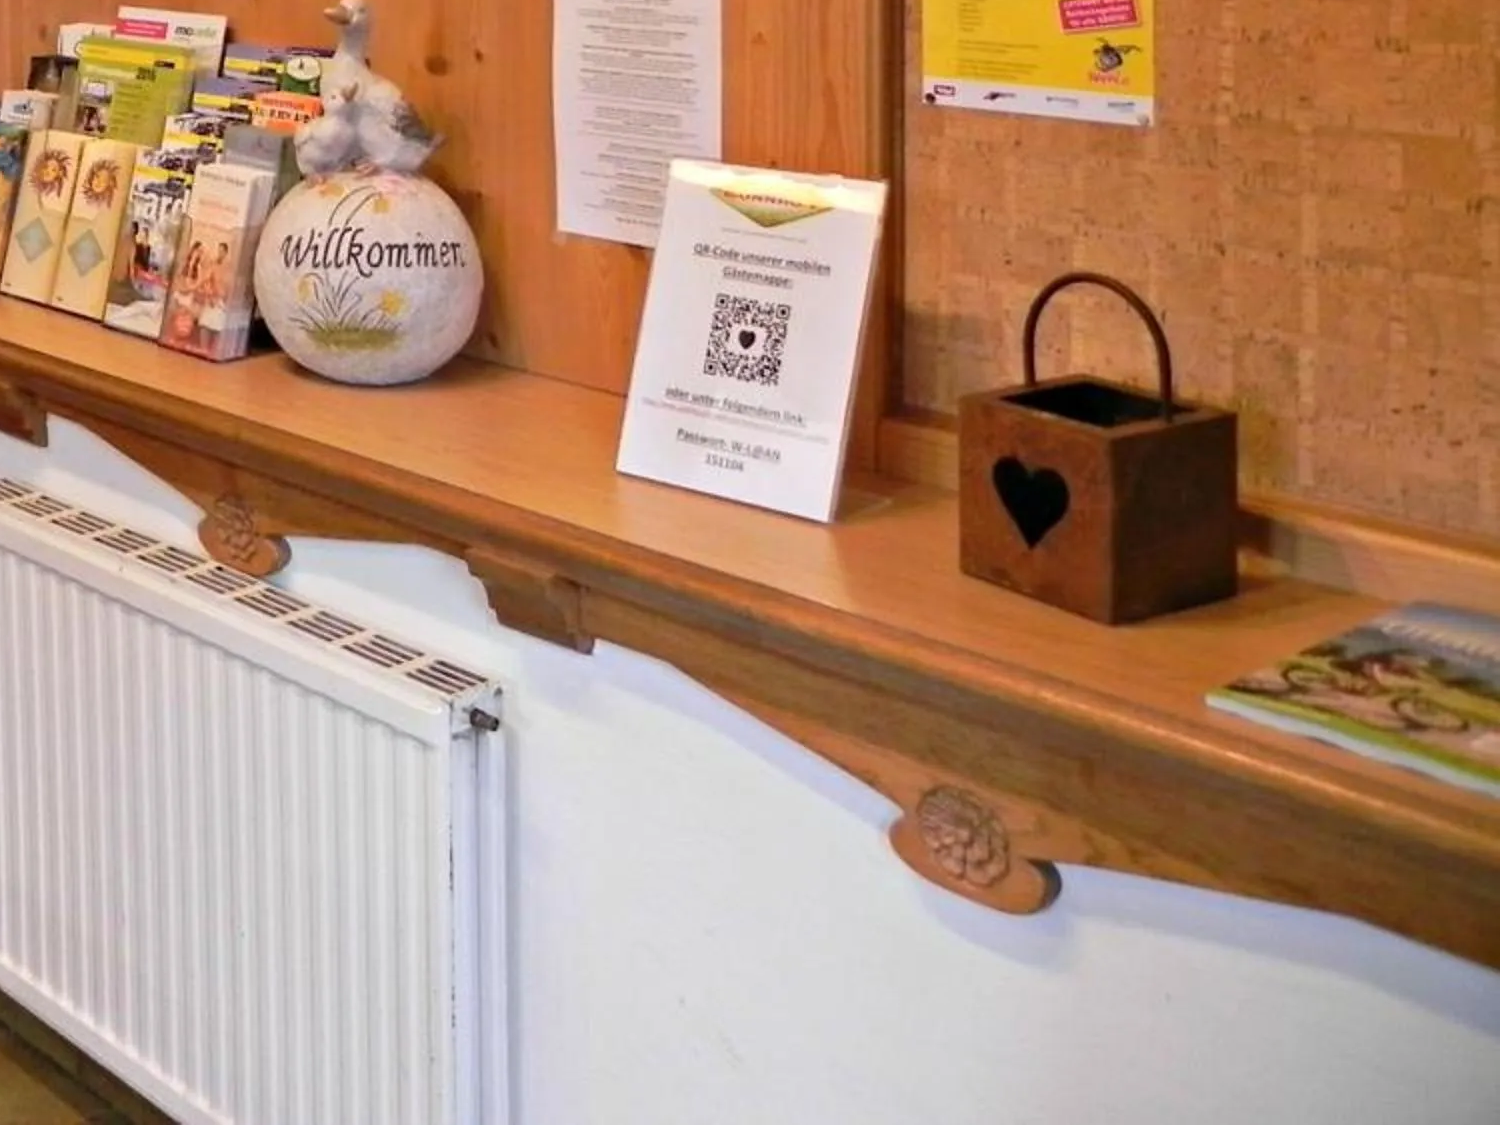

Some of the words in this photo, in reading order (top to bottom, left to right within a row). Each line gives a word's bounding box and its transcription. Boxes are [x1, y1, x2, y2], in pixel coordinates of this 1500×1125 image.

[279, 226, 466, 278] Willkommen
[693, 242, 741, 260] QR-Code
[741, 253, 784, 269] unserer
[785, 259, 831, 276] mobilen
